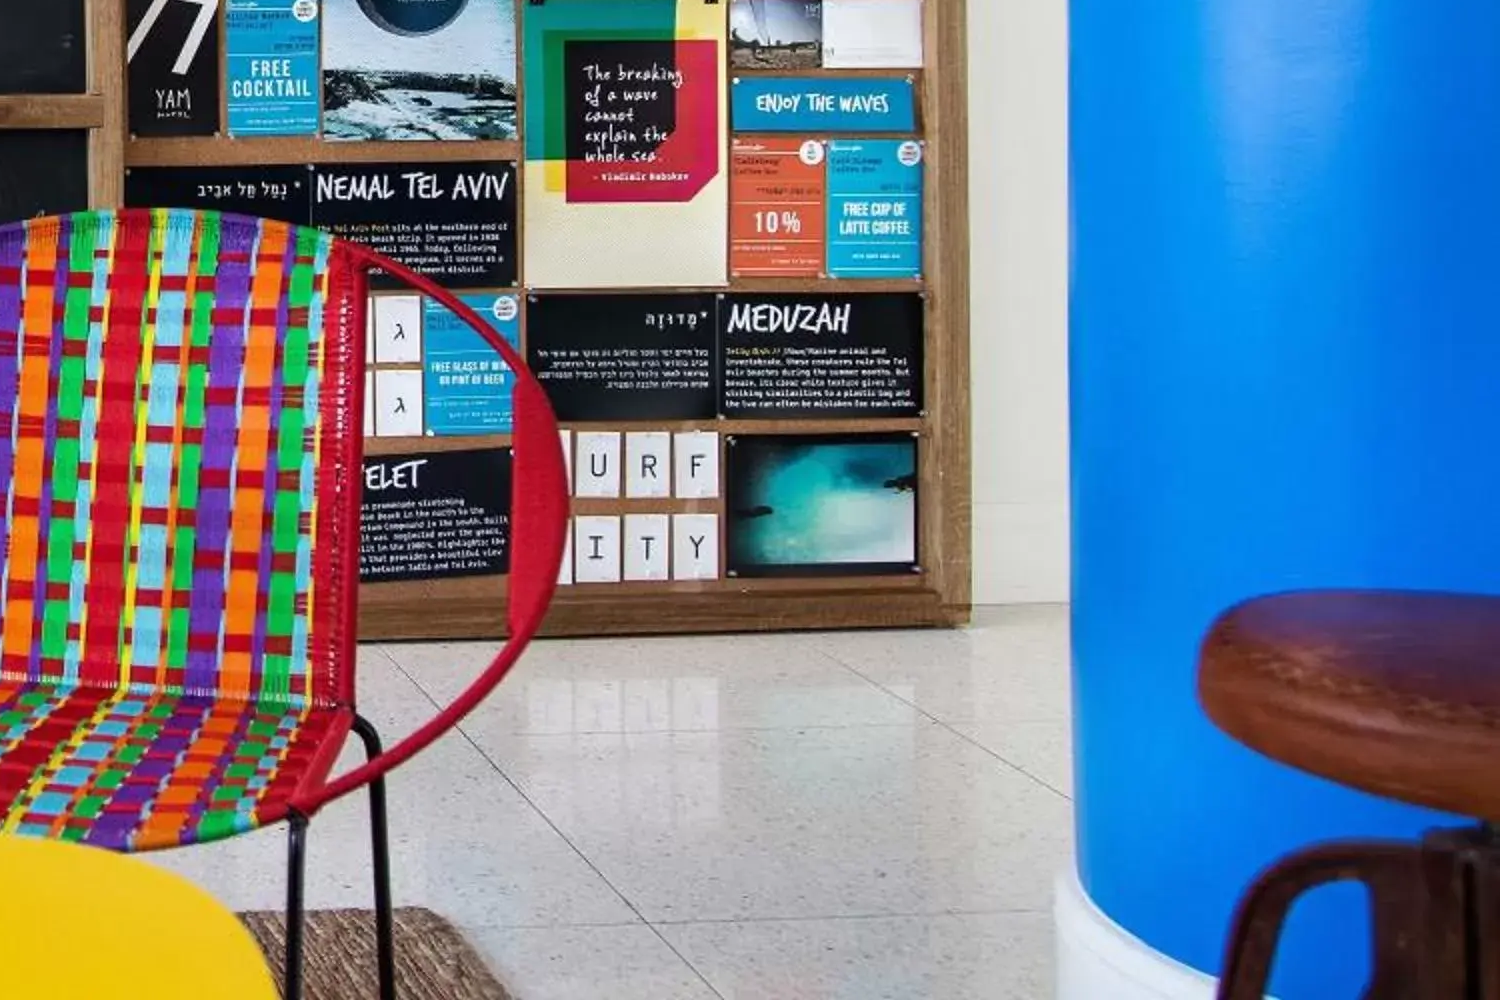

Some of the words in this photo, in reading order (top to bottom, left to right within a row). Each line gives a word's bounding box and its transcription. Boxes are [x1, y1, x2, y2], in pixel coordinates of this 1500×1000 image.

[251, 60, 291, 77] FREE
[583, 63, 611, 81] The
[618, 62, 683, 88] breaking
[232, 80, 311, 97] COCKTAIL
[585, 84, 600, 107] of
[623, 91, 658, 101] wave
[155, 89, 190, 110] YAM
[756, 93, 801, 113] ENJOY
[805, 93, 835, 113] THE
[839, 93, 889, 113] WAVES
[585, 108, 634, 122] cannot
[585, 123, 637, 150] explain
[643, 125, 668, 141] the
[585, 143, 625, 162] whole
[317, 173, 395, 202] NEMAL
[401, 172, 445, 200] TEL
[451, 171, 509, 200] AVIV
[843, 201, 869, 216] FREE
[870, 201, 892, 216] CUP
[840, 220, 870, 235] LATTE
[872, 221, 911, 235] COFFEE
[728, 303, 851, 334] MEDUZAH
[365, 459, 428, 490] ELET
